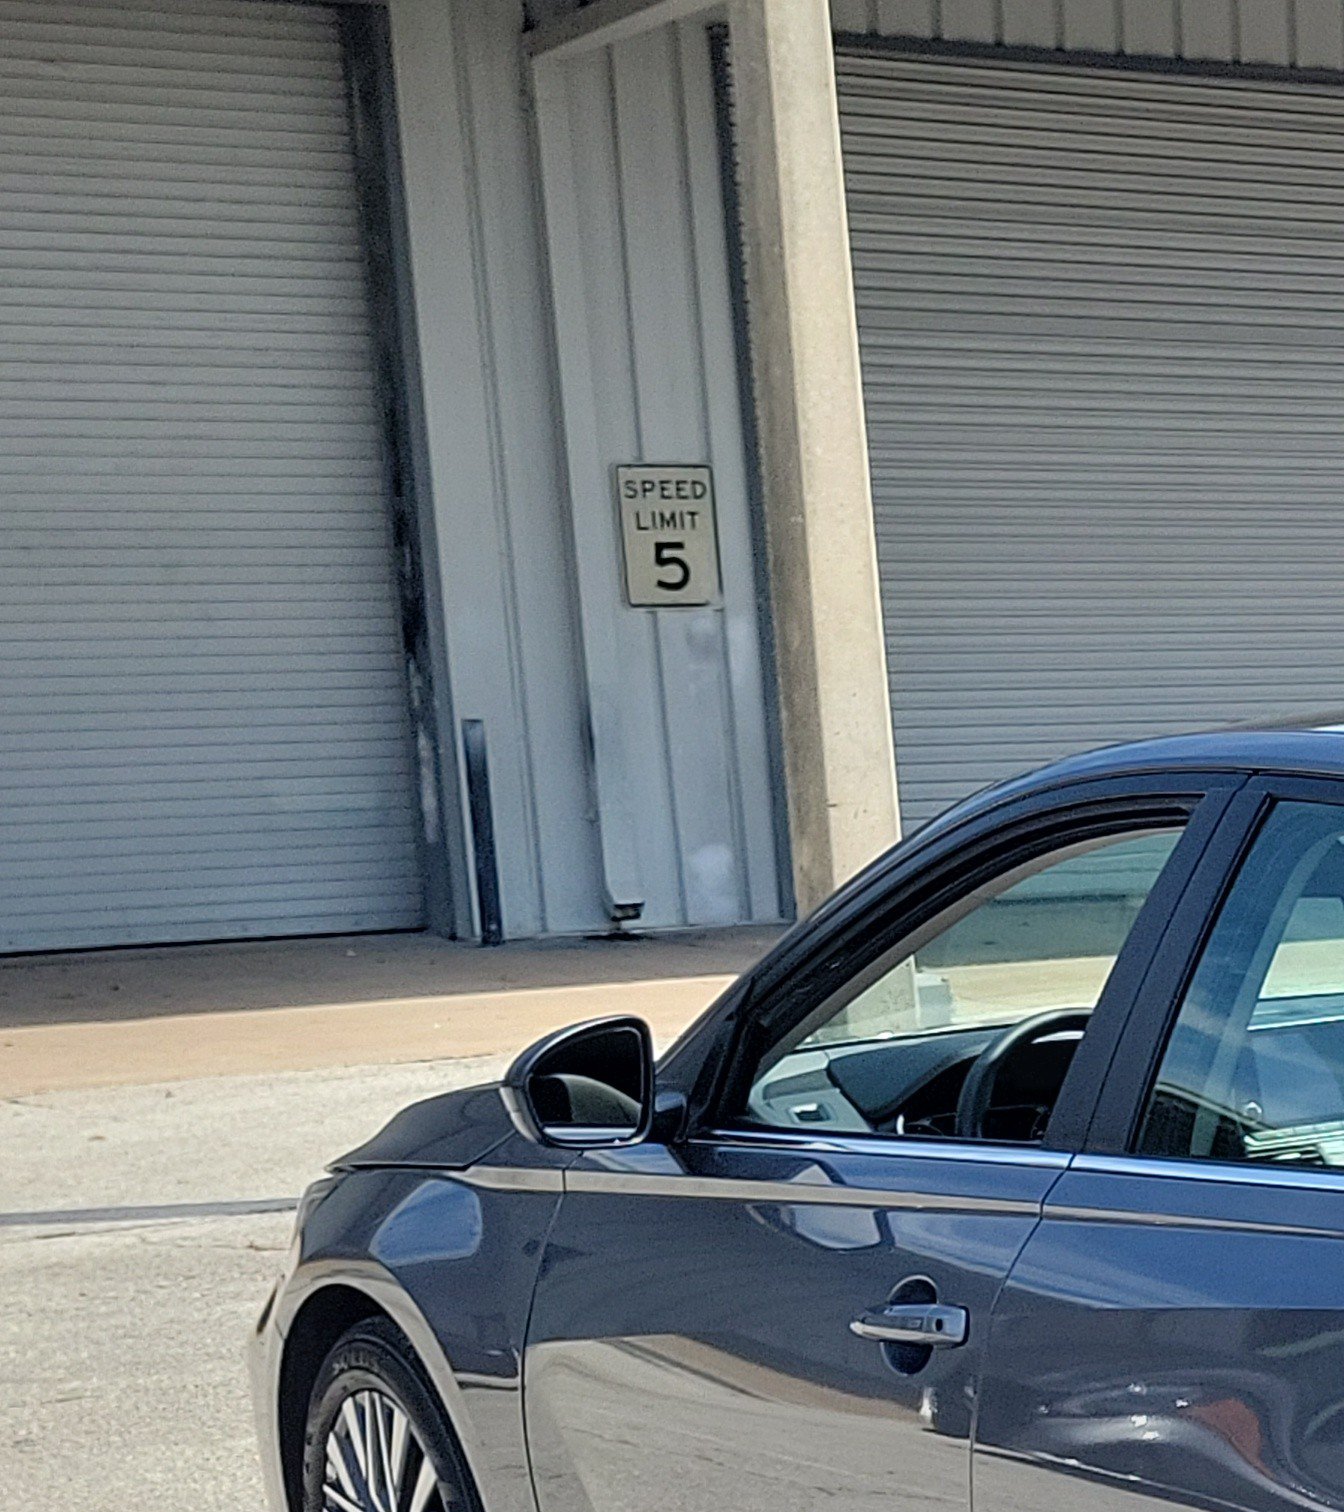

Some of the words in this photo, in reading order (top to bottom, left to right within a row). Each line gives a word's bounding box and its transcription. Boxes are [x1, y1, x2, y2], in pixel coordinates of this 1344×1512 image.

[623, 480, 707, 499] SPEED
[635, 511, 700, 531] LIMIT
[653, 541, 690, 591] 5
